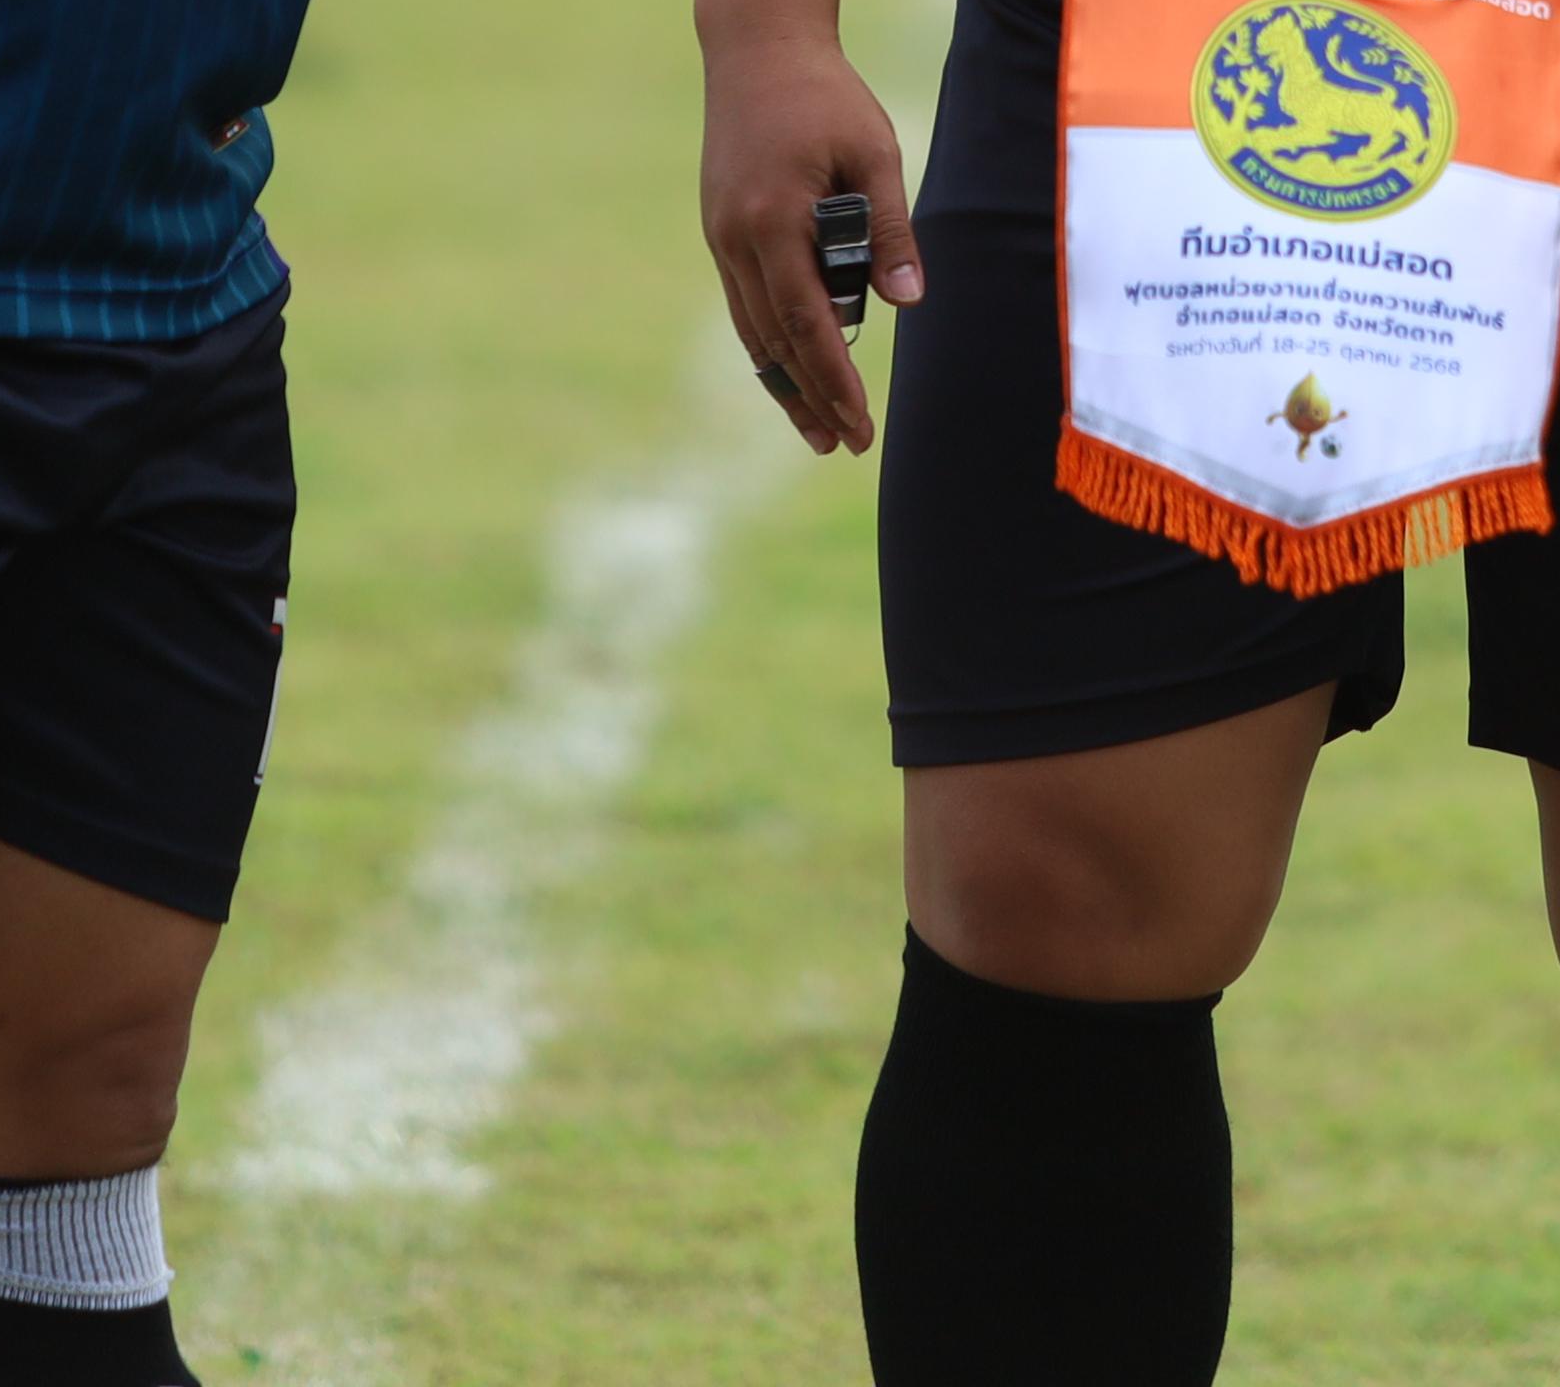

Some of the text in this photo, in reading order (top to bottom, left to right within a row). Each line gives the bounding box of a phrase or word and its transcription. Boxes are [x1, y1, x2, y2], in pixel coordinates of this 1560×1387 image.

[1180, 224, 1453, 282] ทีมอำเภอแม่สอด
[1175, 303, 1454, 346] อำเภอแม่สอด จังหวัดตาก
[1272, 335, 1331, 358] 18-25
[1339, 343, 1401, 370] ตุลาคม
[1409, 353, 1462, 377] 2568
